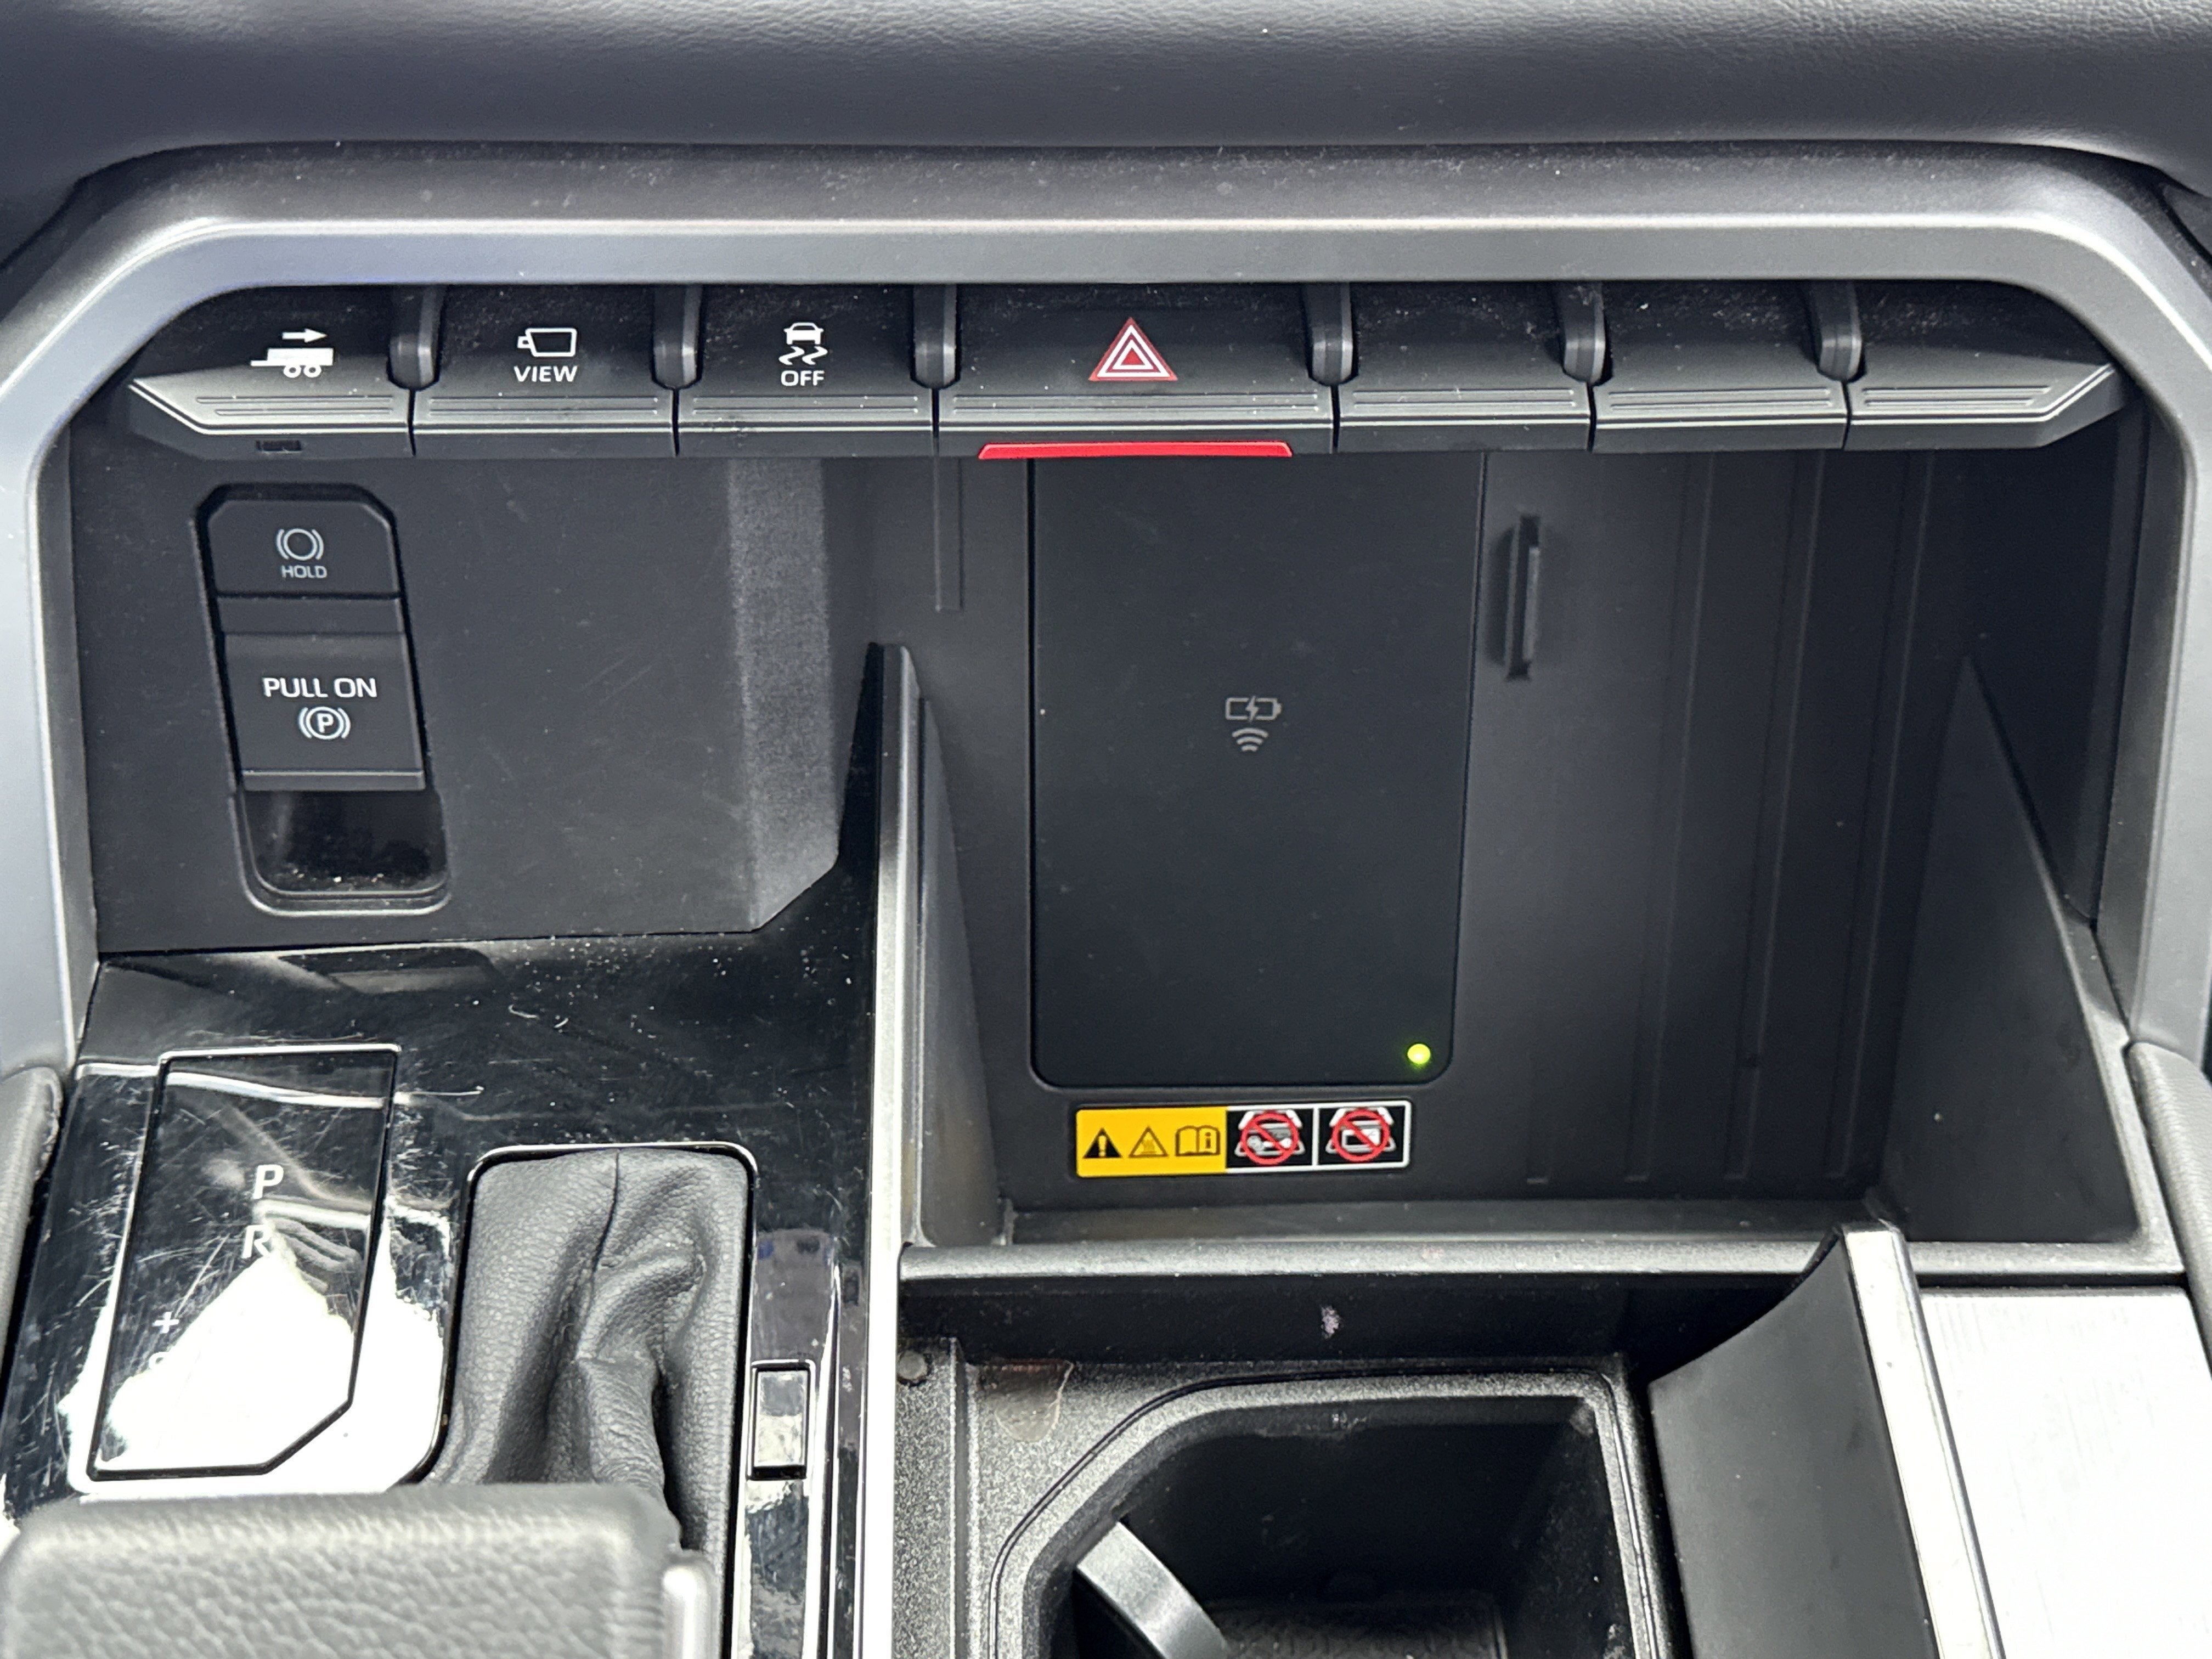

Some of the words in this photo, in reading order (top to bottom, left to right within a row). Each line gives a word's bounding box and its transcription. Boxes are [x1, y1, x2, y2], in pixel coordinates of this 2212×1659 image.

[514, 365, 578, 383] VIEW
[781, 369, 824, 386] OFF
[281, 565, 327, 579] HOLD
[262, 678, 328, 698] PULL
[334, 678, 378, 698] ON
[317, 712, 334, 733] P
[253, 1164, 284, 1200] P
[241, 1224, 272, 1259] R
